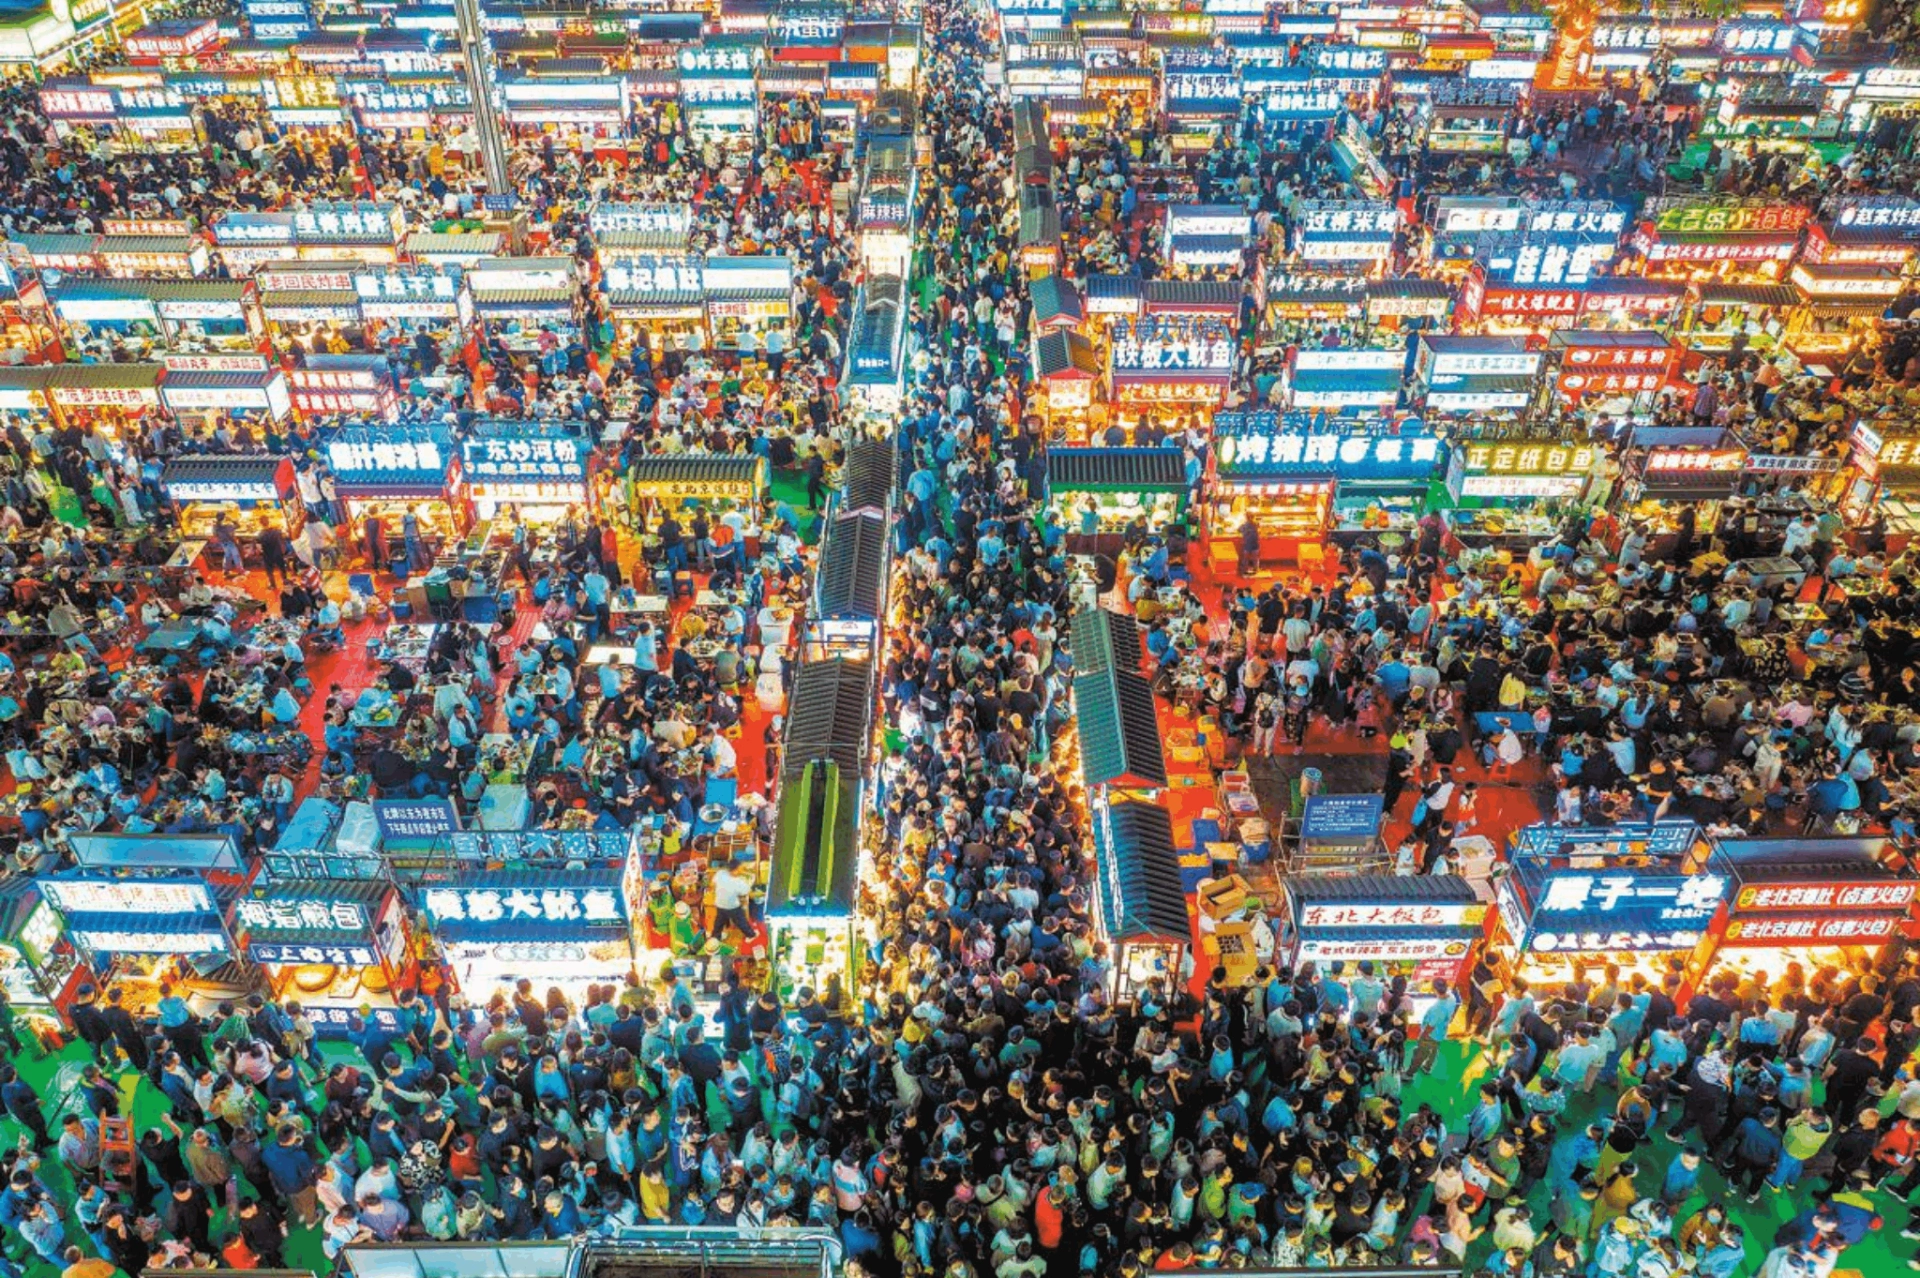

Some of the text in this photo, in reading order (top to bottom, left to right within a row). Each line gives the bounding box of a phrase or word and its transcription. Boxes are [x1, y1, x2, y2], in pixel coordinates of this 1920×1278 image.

[862, 203, 905, 220] 麻辣拌
[1306, 210, 1399, 232] 过桥米线
[1117, 340, 1231, 368] 铁板大鱿鱼
[463, 438, 577, 462] 广东炒河粉
[1466, 447, 1594, 471] 正定纸包鱼
[1306, 905, 1445, 926] 东北大饭包
